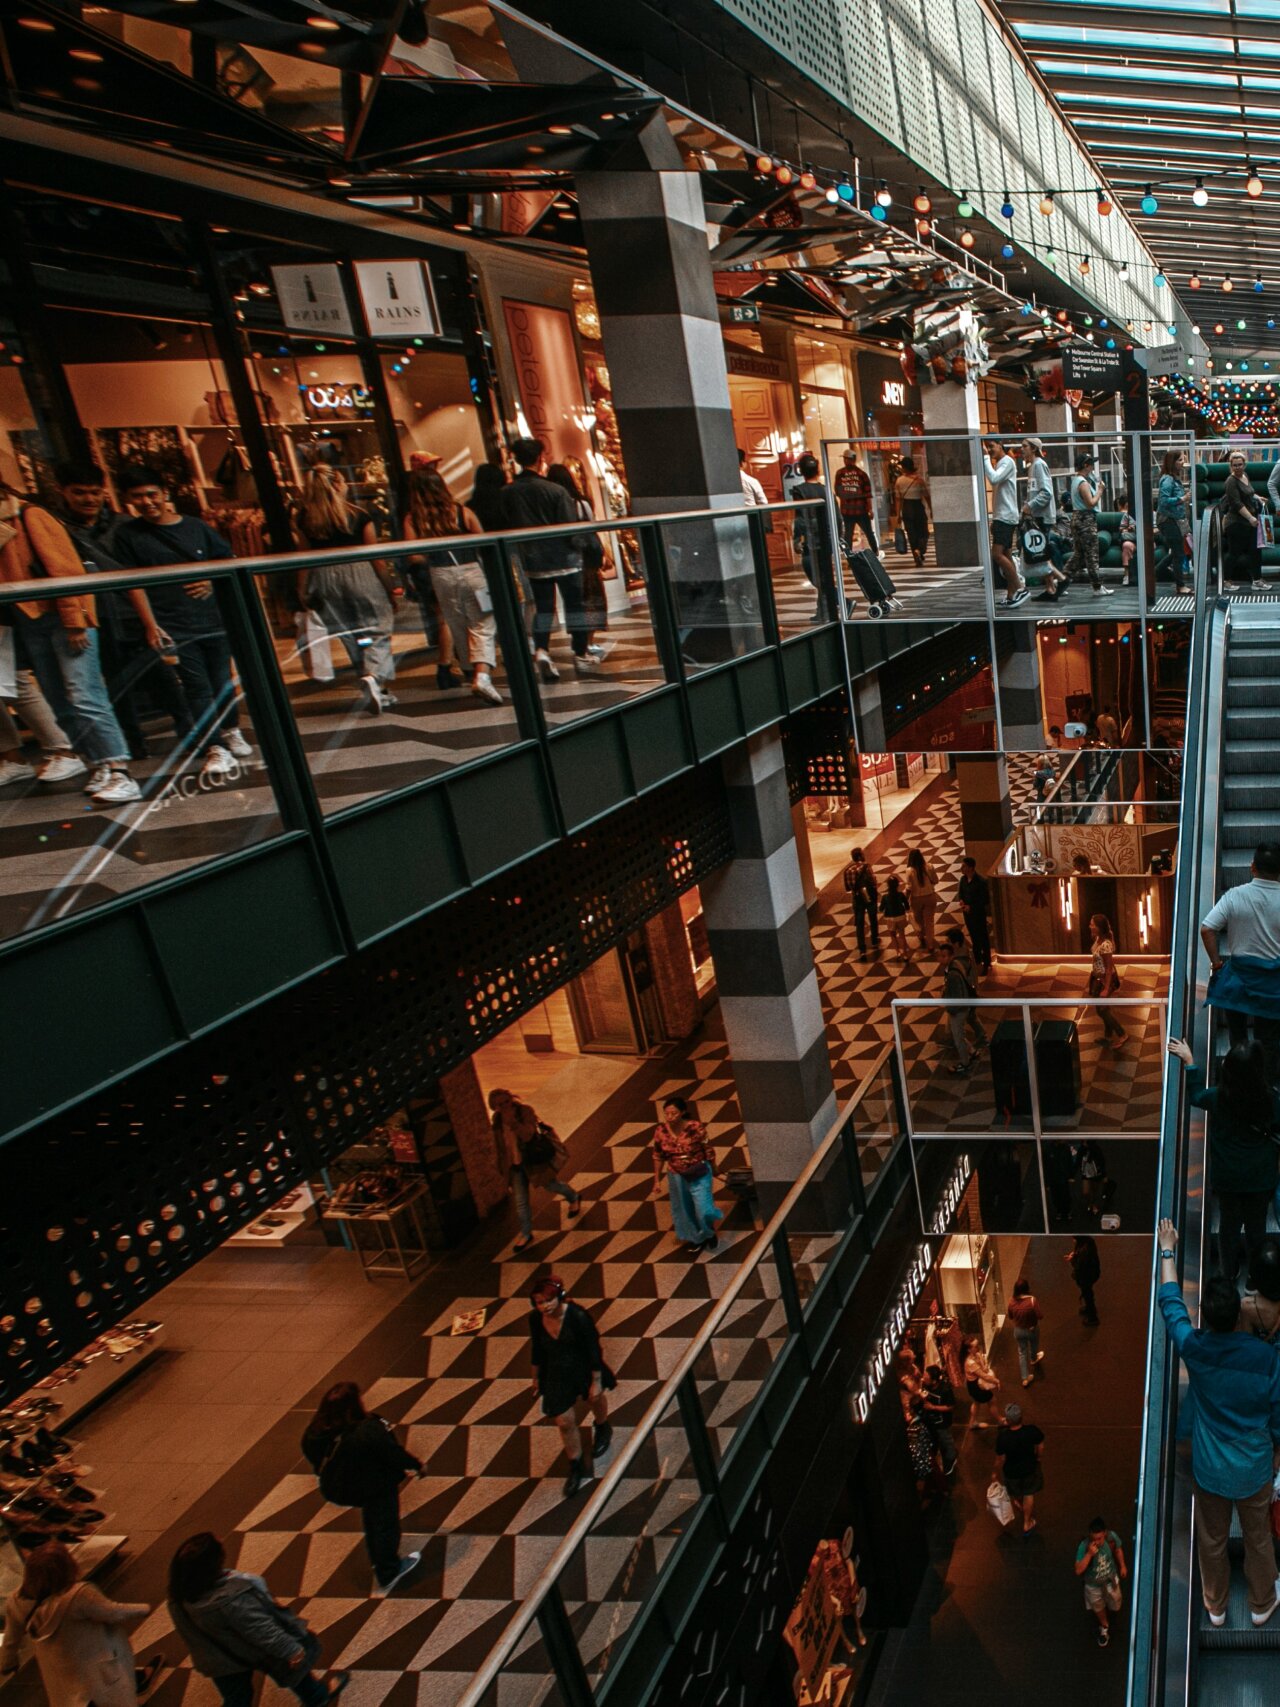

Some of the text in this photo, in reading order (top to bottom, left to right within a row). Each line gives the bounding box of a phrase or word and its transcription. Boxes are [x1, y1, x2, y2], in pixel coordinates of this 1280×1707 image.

[375, 306, 421, 319] RAINS
[882, 380, 905, 406] JNBY
[1028, 534, 1043, 548] JD
[855, 1241, 931, 1424] DANGERFIELD
